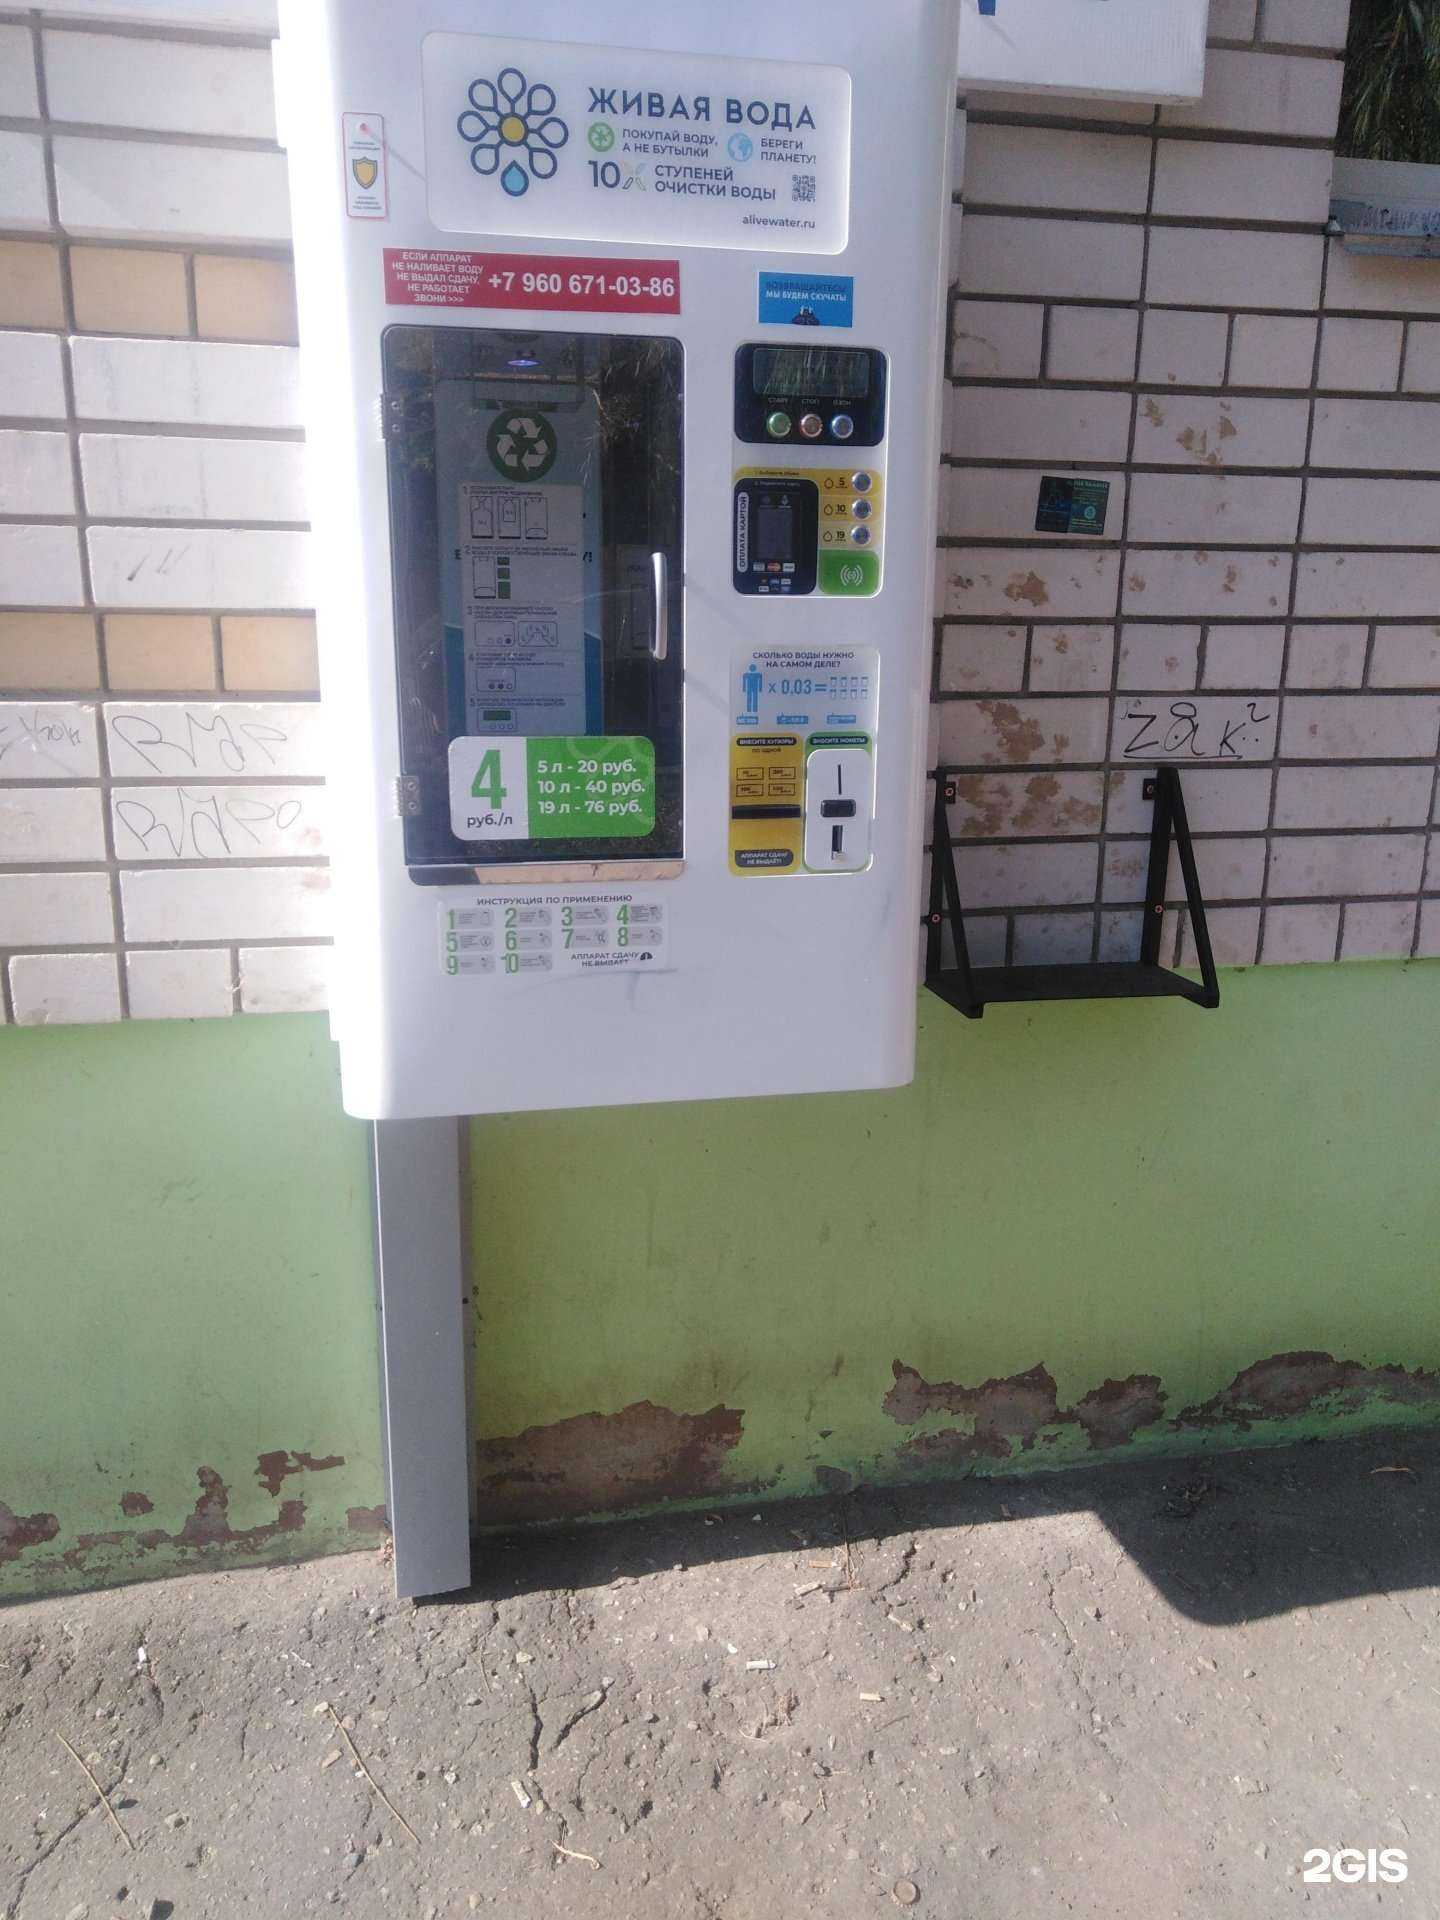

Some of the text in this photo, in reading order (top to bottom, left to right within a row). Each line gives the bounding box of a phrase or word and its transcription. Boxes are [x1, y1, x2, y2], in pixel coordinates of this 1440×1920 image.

[588, 87, 816, 132] ЖИВАЯ ВОДА
[622, 128, 718, 147] ПОКУПАЙ ВОДУ,
[760, 138, 803, 150] БЕРЕГИ
[622, 143, 709, 158] А НЕ БУТЫЛКИ
[760, 151, 816, 165] ПЛАНЕТУ!
[655, 163, 733, 181] СТУПЕНЕЙ
[655, 180, 776, 201] ОЧИСТКИ ВОДЫ
[742, 214, 816, 230] alivewater.ru
[402, 251, 472, 263] ЕСЛИ АППАРАТ
[392, 262, 405, 271] НЕ
[406, 262, 456, 273] НАЛИВАЕТ
[397, 272, 480, 285] НЕ ВЫДАЛ СДАЧУ,
[488, 271, 675, 297] +7 960 671-03-86
[407, 283, 470, 294] НЕ РАБОТАЕТ
[766, 289, 780, 298] МЫ
[782, 289, 809, 300] БУДЕМ
[415, 293, 447, 303] ЗВОНИ
[840, 477, 845, 486] 5
[837, 504, 846, 513] 10
[738, 496, 747, 568] ОПЛАТА КАРТОЙ
[836, 531, 845, 539] 19
[752, 652, 793, 660] СКОЛЬКО
[795, 652, 821, 660] ВОДЫ
[766, 660, 841, 669] НА САМОМ ДЕЛЕ?
[781, 679, 812, 695] 0.03
[537, 760, 548, 773] 5
[551, 762, 562, 773] л
[577, 760, 598, 773] 20
[602, 759, 636, 776] руб.
[471, 749, 507, 810] 4
[538, 780, 555, 794] 10
[559, 782, 571, 793] л
[585, 780, 607, 793] 40
[611, 779, 645, 796] руб.
[538, 801, 555, 814] 19
[559, 803, 571, 814] л
[585, 800, 605, 814] 76
[609, 800, 642, 816] руб.
[467, 812, 512, 828] руб./л
[477, 894, 633, 906] ИНСТРУКЦИЯ ПО ПРИМЕНЕНИЮ
[447, 909, 455, 930] 1
[505, 907, 517, 928] 2
[561, 906, 573, 927] 3
[616, 904, 629, 925] 4
[446, 932, 458, 952] 5
[505, 930, 517, 951] 6
[561, 928, 574, 949] 7
[617, 926, 629, 947] 8
[571, 951, 640, 961] АППАРАТ СДАЧУ
[446, 954, 459, 975] 9
